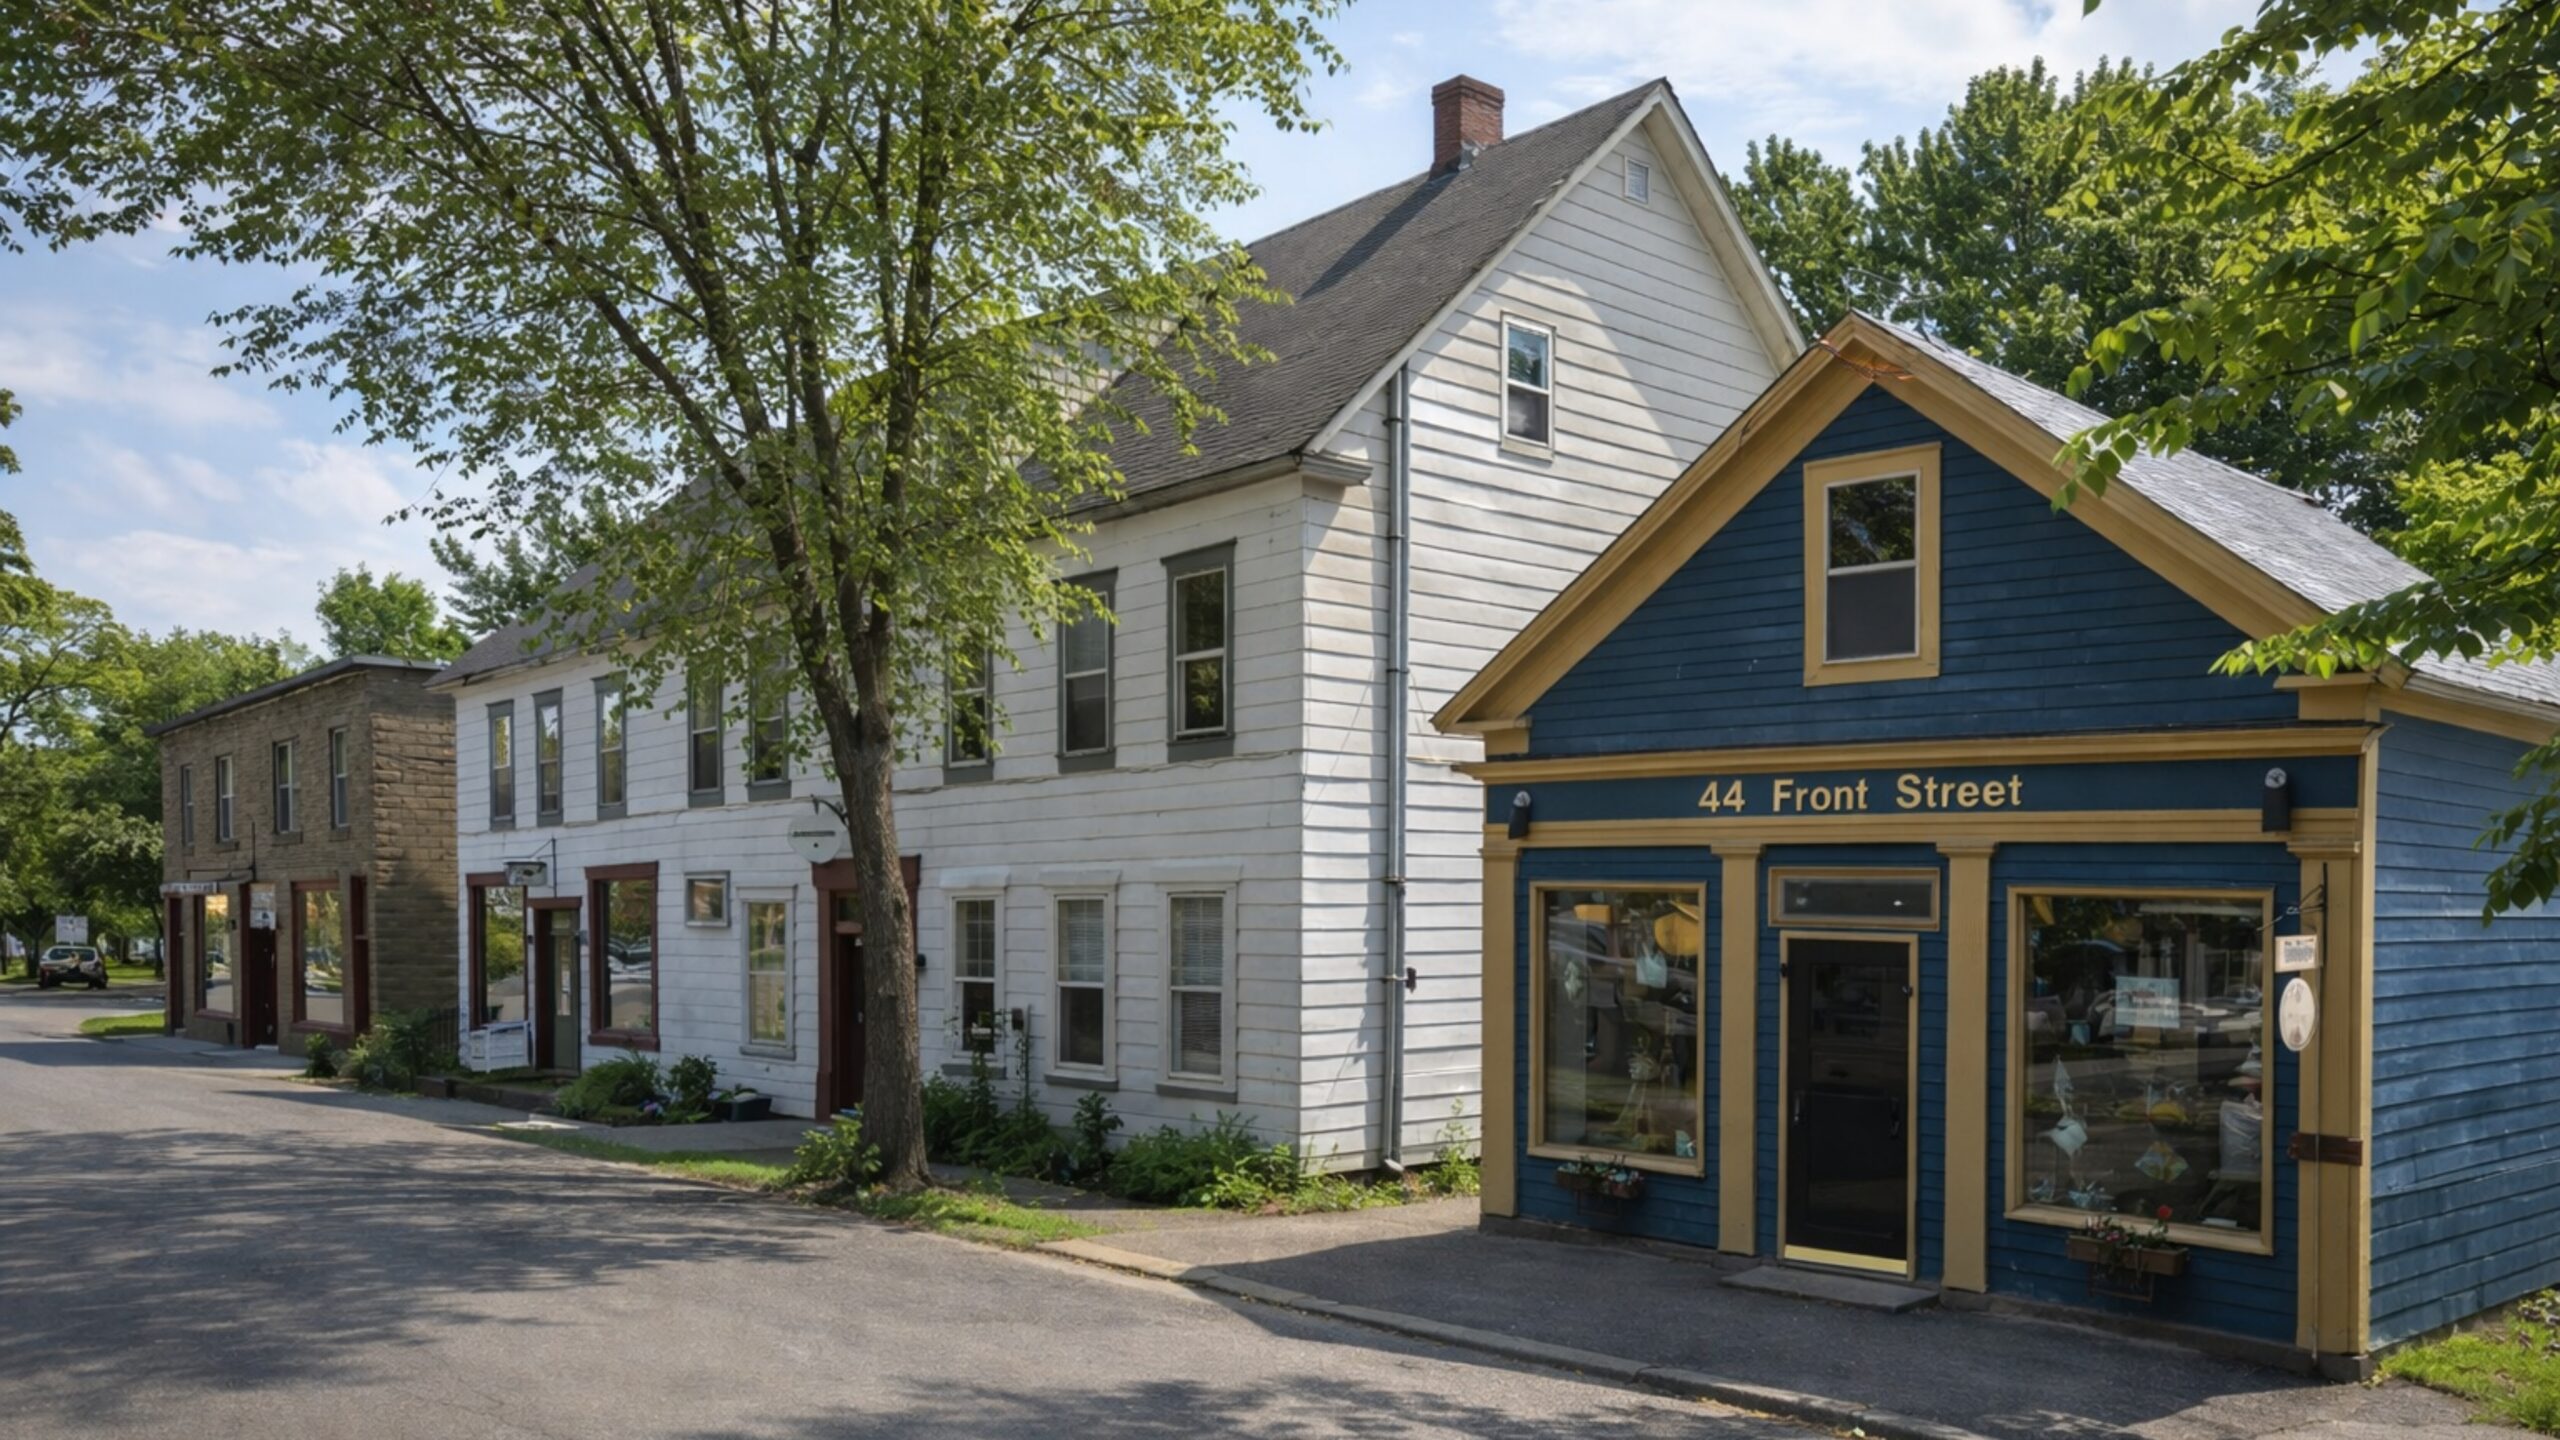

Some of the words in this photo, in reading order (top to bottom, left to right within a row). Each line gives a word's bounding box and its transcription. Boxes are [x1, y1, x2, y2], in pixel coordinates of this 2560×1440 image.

[1698, 779, 1746, 813] 44
[1772, 777, 1868, 812] Front
[1896, 773, 2023, 809] Street
